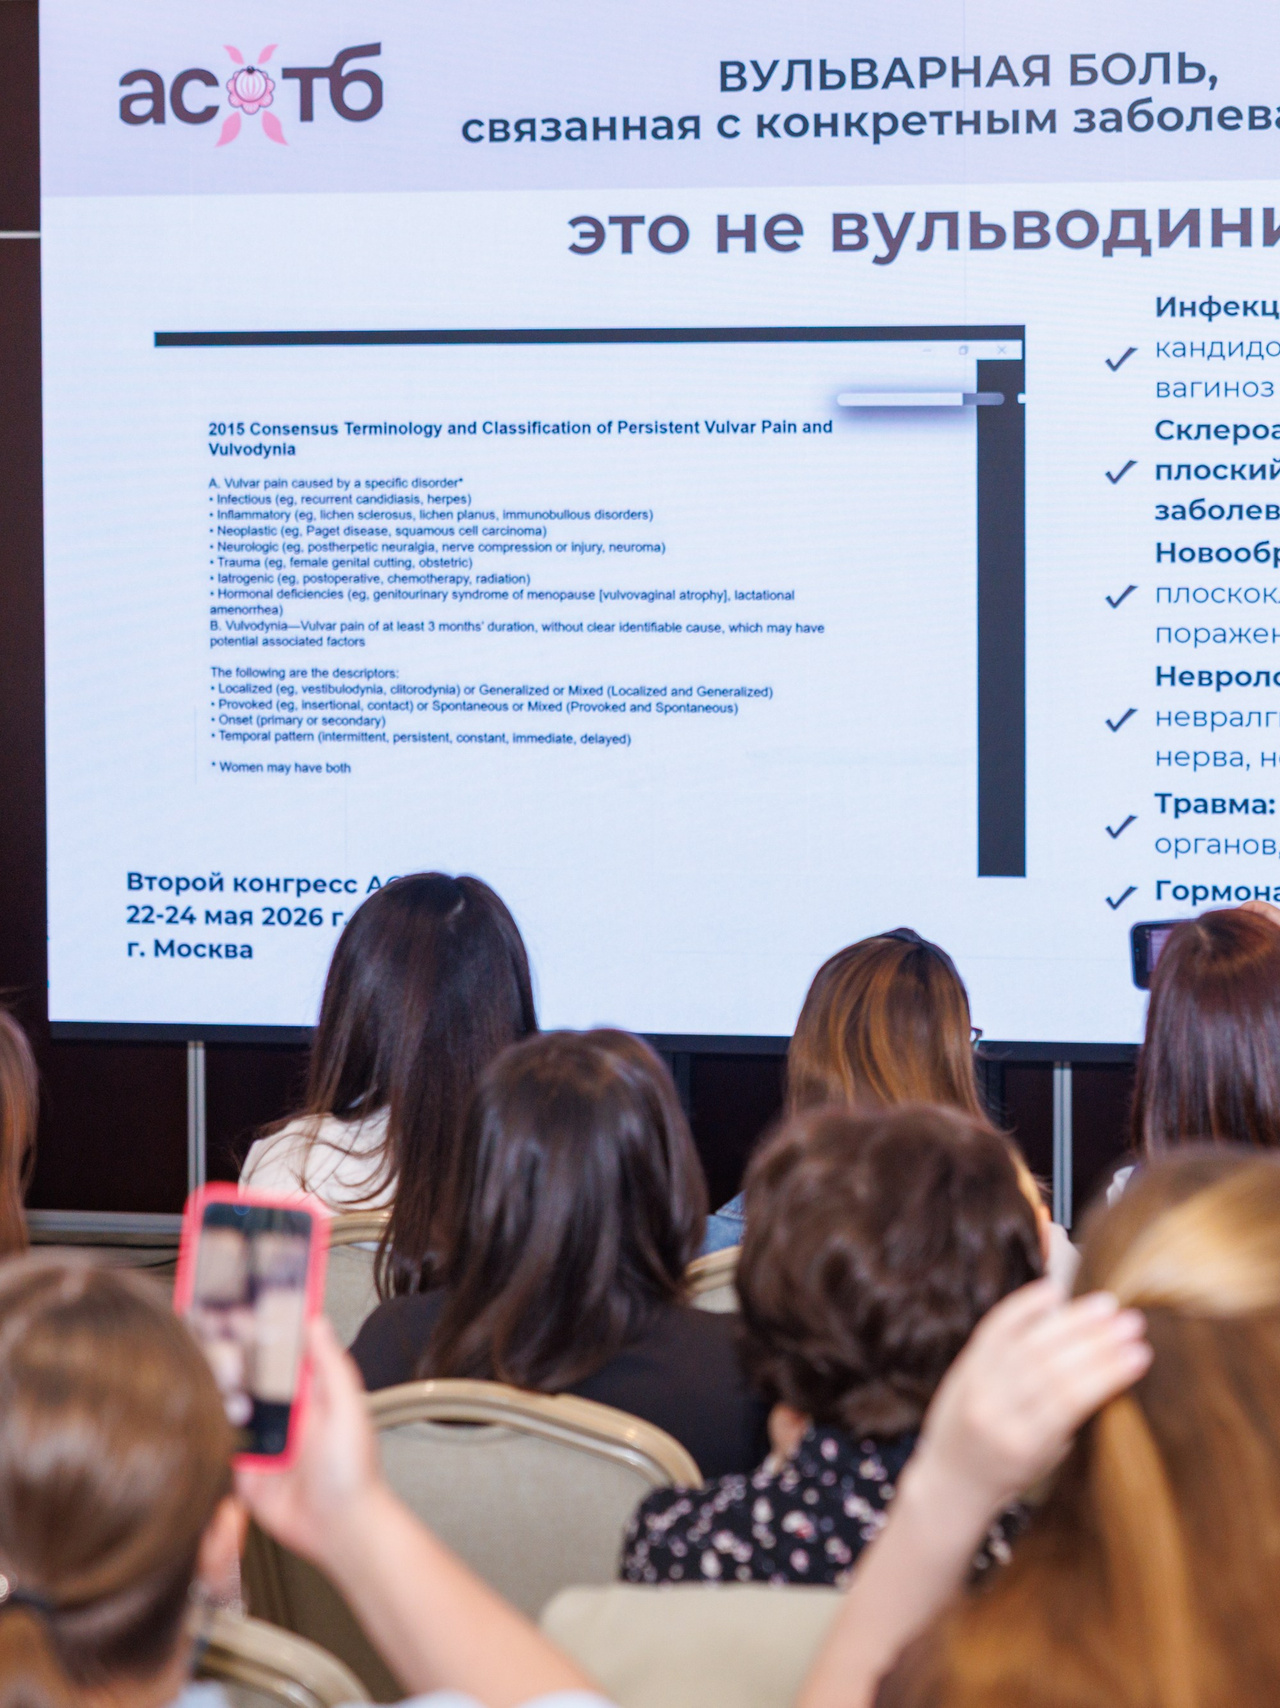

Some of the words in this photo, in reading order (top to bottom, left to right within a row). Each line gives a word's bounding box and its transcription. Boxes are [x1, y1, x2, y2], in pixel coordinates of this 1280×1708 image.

[719, 54, 1050, 93] ВУЛЬВАРНАЯ
[1069, 51, 1218, 91] БОЛЬ,
[461, 114, 700, 144] связанная
[716, 114, 741, 139] с
[756, 108, 1056, 145] конкретным
[566, 214, 690, 256] это
[716, 212, 805, 254] не
[1156, 380, 1274, 398] вагиноз
[208, 422, 245, 436] 2015
[249, 422, 339, 436] Consensus
[343, 421, 443, 439] Terminology
[447, 420, 477, 435] and
[481, 420, 591, 435] Classification
[596, 420, 613, 434] of
[617, 420, 700, 434] Persistent
[703, 420, 756, 434] Vulvar
[761, 419, 797, 434] Pain
[801, 419, 833, 434] and
[208, 442, 296, 459] Vulvodynia
[208, 477, 220, 489] A.
[223, 477, 260, 489] Vulvar
[263, 478, 288, 491] pain
[290, 477, 334, 489] caused
[336, 477, 351, 491] by
[353, 479, 362, 489] a
[364, 476, 408, 491] specific
[216, 493, 272, 505] Infectious
[300, 494, 353, 505] recurrent
[355, 493, 424, 505] candidiasis,
[426, 493, 472, 507] herpes)
[216, 509, 292, 523] Inflammatory
[319, 509, 354, 520] lichen
[357, 509, 416, 521] sclerosus,
[418, 509, 454, 520] lichen
[456, 509, 499, 523] planus,
[502, 509, 591, 520] immunobullous
[593, 509, 654, 522] disorders)
[216, 525, 278, 539] Neoplastic
[305, 524, 340, 539] Paget
[342, 525, 392, 537] disease,
[394, 526, 455, 538] squamous
[457, 524, 478, 536] cell
[481, 525, 547, 538] carcinoma)
[216, 555, 261, 568] Trauma
[289, 556, 329, 568] female
[331, 556, 370, 571] genital
[373, 557, 415, 571] cutting,
[418, 556, 473, 570] obstetric)
[217, 572, 274, 587] Iatrogenic
[302, 572, 384, 586] postoperative,
[386, 573, 472, 587] chemotherapy,
[475, 573, 531, 586] radiation)
[217, 587, 274, 599] Hormonal
[275, 588, 344, 600] deficiencies
[372, 588, 449, 602] genitourinary
[451, 588, 510, 602] syndrome
[511, 588, 524, 600] of
[526, 590, 596, 603] menopause
[598, 588, 676, 603] [vulvovaginal
[734, 589, 795, 601] lactational
[209, 604, 284, 617] amenorrhea)
[209, 666, 233, 678] The
[235, 666, 286, 681] following
[288, 668, 308, 678] are
[310, 667, 329, 679] the
[331, 667, 399, 681] descriptors:
[217, 682, 273, 694] Localized
[301, 683, 386, 697] vestibulodynia,
[389, 683, 461, 698] clitorodynia)
[463, 686, 476, 695] or
[478, 683, 550, 696] Generalized
[552, 686, 565, 696] or
[567, 684, 604, 696] Mixed
[606, 685, 668, 698] (Localized
[670, 686, 693, 697] and
[696, 685, 774, 700] Generalized)
[218, 713, 253, 725] Onset
[255, 714, 304, 728] (primary
[305, 716, 319, 726] or
[321, 715, 386, 729] secondary)
[218, 729, 271, 744] Temporal
[273, 730, 315, 743] pattern
[317, 730, 389, 744] (intermittent,
[392, 732, 453, 745] persistent,
[455, 732, 509, 744] constant,
[512, 732, 576, 745] immediate,
[579, 732, 632, 747] delayed)
[218, 761, 264, 773] Women
[266, 763, 292, 776] may
[293, 762, 323, 773] have
[325, 762, 352, 773] both
[1156, 750, 1250, 773] нерва,
[1153, 792, 1276, 819] Травма:
[126, 871, 224, 896] Второй
[232, 876, 358, 898] конгресс
[126, 904, 197, 925] 22-24
[204, 909, 253, 926] мая
[261, 906, 324, 927] 2026
[127, 941, 145, 957] г.
[153, 938, 253, 959] Москва
